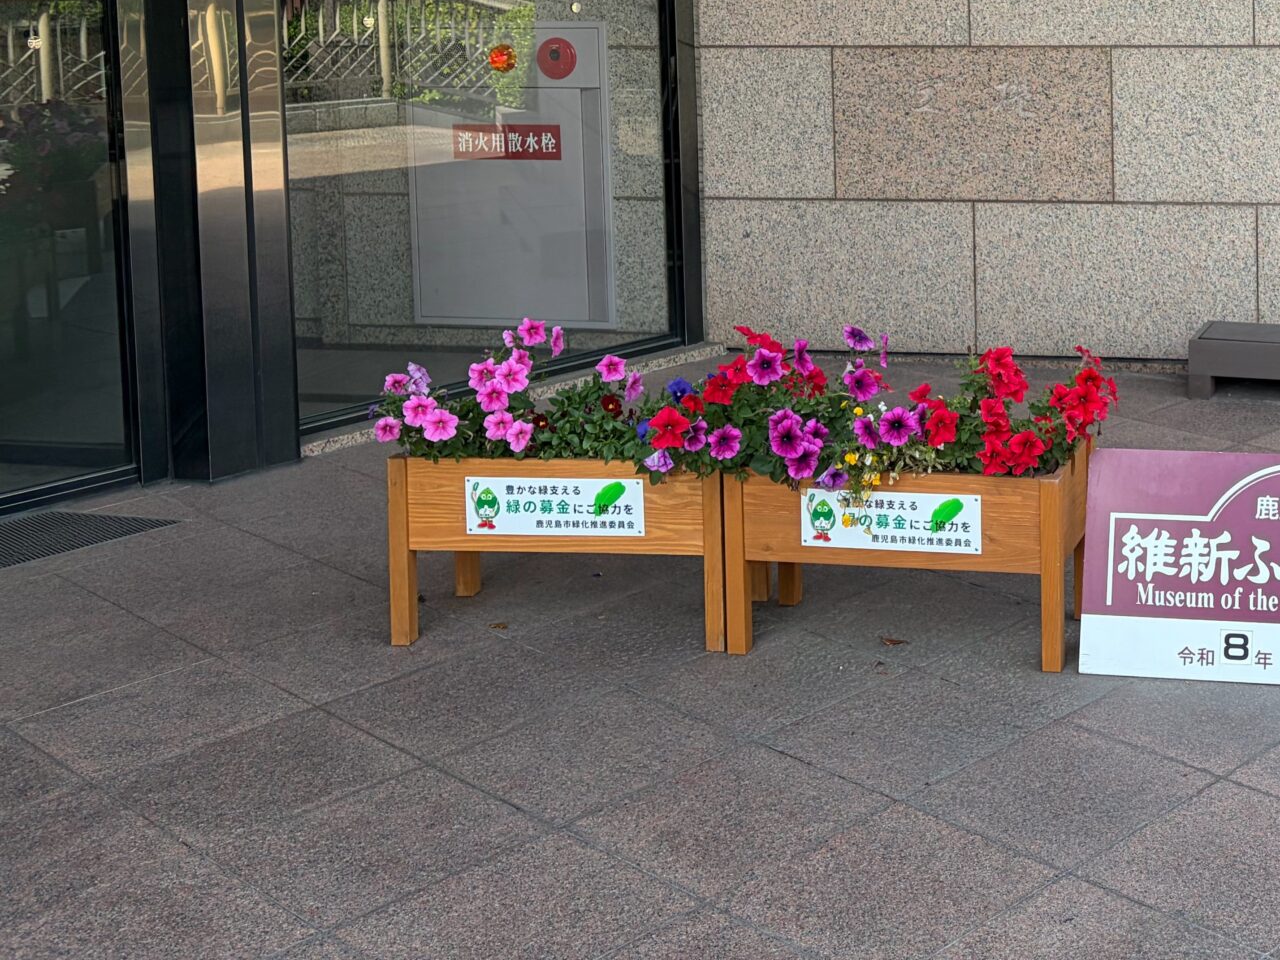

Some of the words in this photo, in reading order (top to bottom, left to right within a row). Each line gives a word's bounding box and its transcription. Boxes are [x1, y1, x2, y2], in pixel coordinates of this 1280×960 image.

[458, 132, 556, 153] 消火用散水栓
[505, 485, 581, 496] 豊かな緑支える
[506, 499, 634, 515] 緑の募金にご協力を
[843, 497, 918, 511] な緑支える
[536, 519, 635, 529] 鹿児島市緑化推進委員会
[872, 534, 972, 548] 鹿児島市緑化推進委員会
[1136, 582, 1215, 610] Museum
[1221, 590, 1243, 610] of
[1249, 590, 1279, 612] the
[1178, 633, 1273, 670] 令和8年
